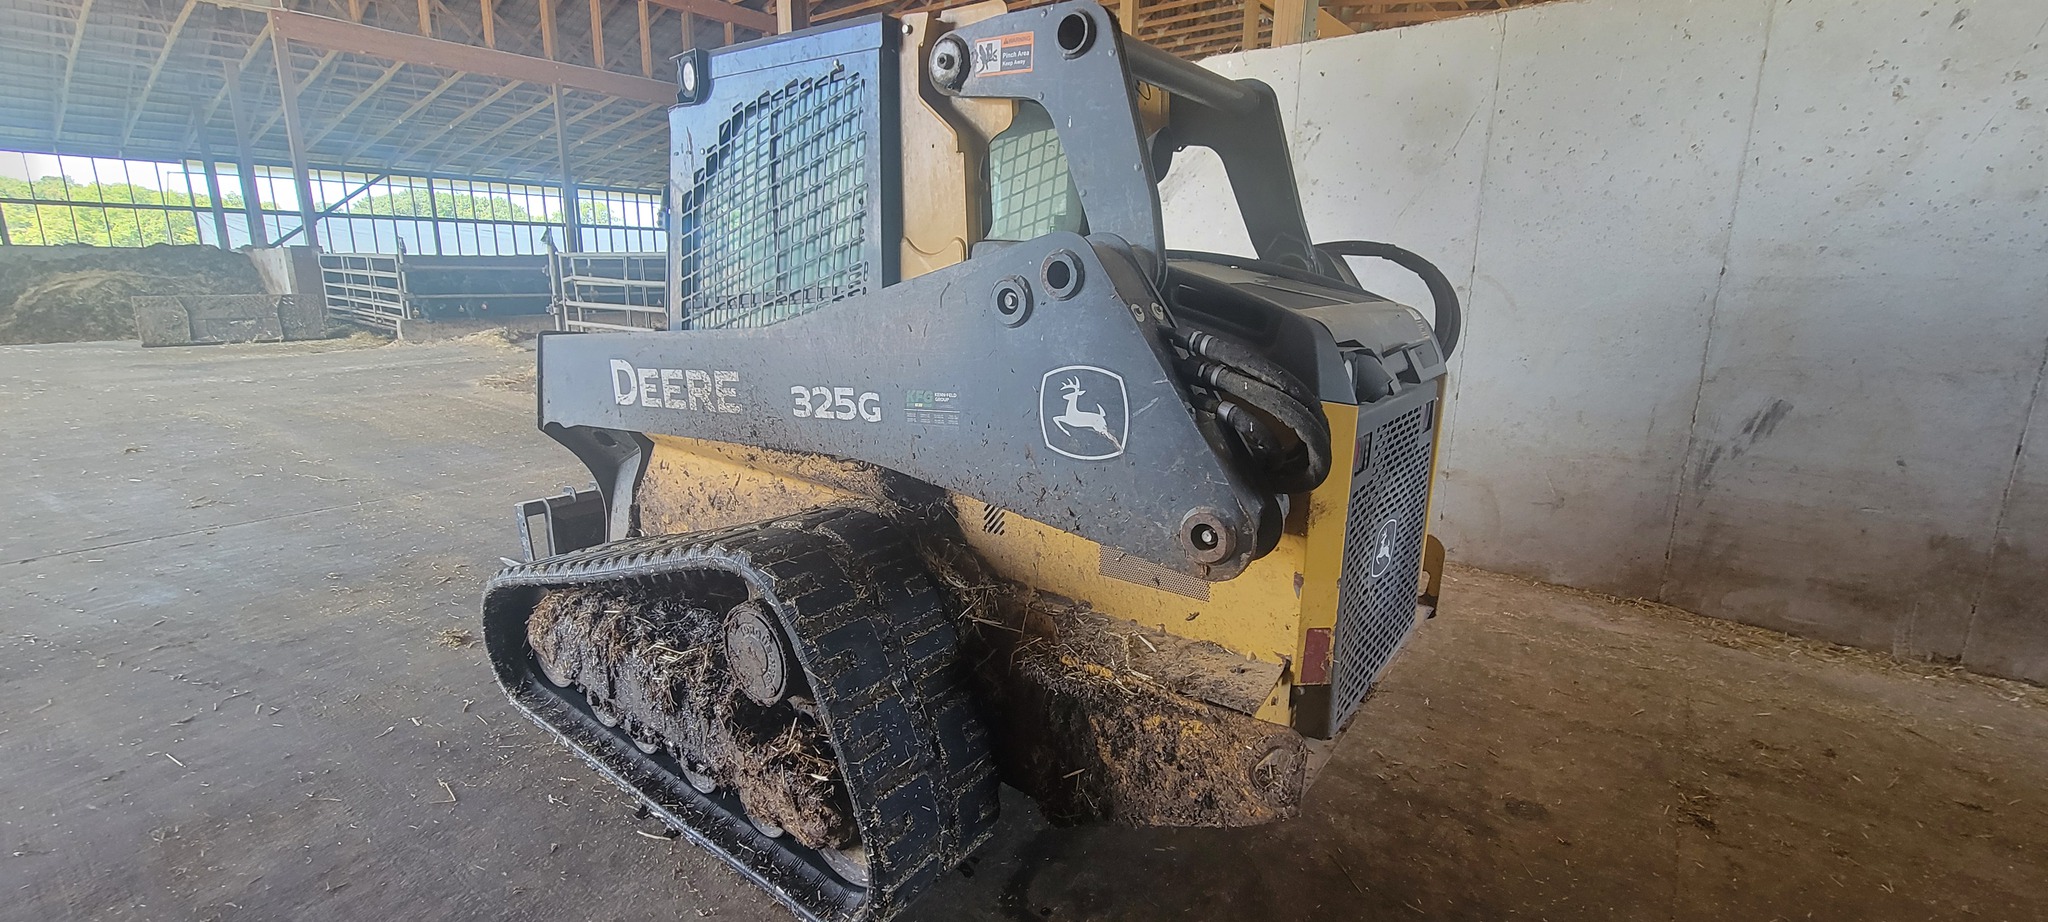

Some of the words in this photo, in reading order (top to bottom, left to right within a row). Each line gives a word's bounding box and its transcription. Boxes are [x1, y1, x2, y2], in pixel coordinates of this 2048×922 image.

[1002, 51, 1017, 59] Pinch
[609, 358, 743, 414] DEERE
[906, 389, 934, 403] KFG
[790, 385, 882, 423] 325G
